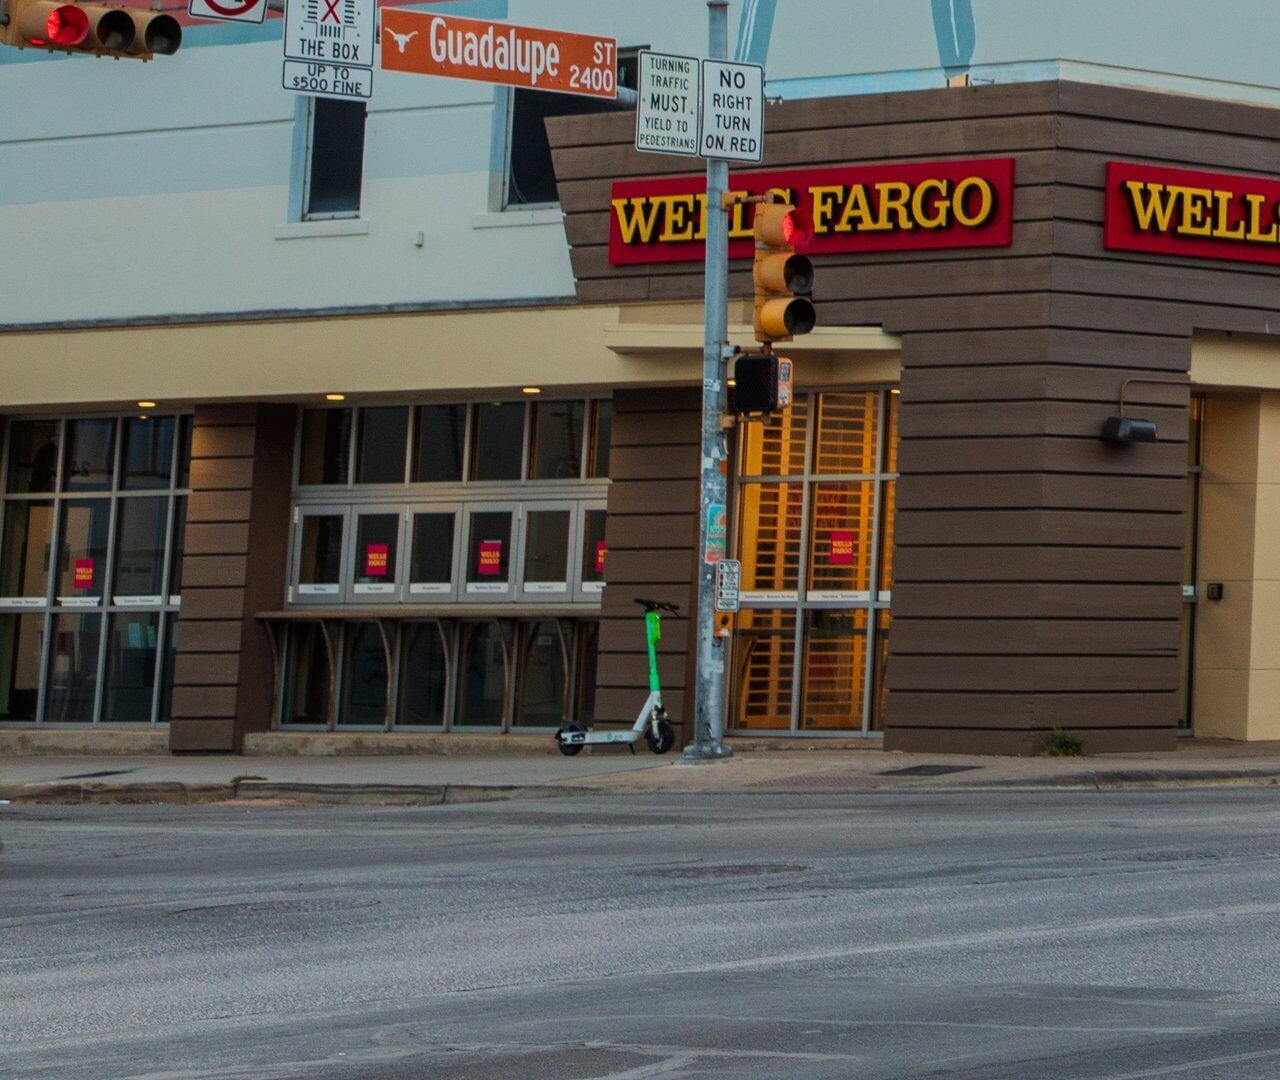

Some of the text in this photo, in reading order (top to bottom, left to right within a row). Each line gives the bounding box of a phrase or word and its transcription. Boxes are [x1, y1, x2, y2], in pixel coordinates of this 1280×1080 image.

[299, 38, 360, 61] THE BOX
[429, 17, 560, 85] Guadalupe
[593, 41, 614, 65] ST
[308, 64, 350, 81] UP TO
[650, 57, 690, 74] TURNING
[293, 76, 363, 95] $500 FINE
[569, 65, 613, 92] 2400
[651, 75, 689, 90] TRAFFIC
[720, 70, 745, 89] NO
[650, 93, 687, 113] MUST
[713, 93, 752, 111] RIGHT
[645, 116, 688, 133] YIELD TO
[715, 114, 750, 131] TURN
[640, 133, 695, 149] PEDESTRIANS
[706, 134, 757, 153] ON RED
[809, 176, 992, 234] FARGO
